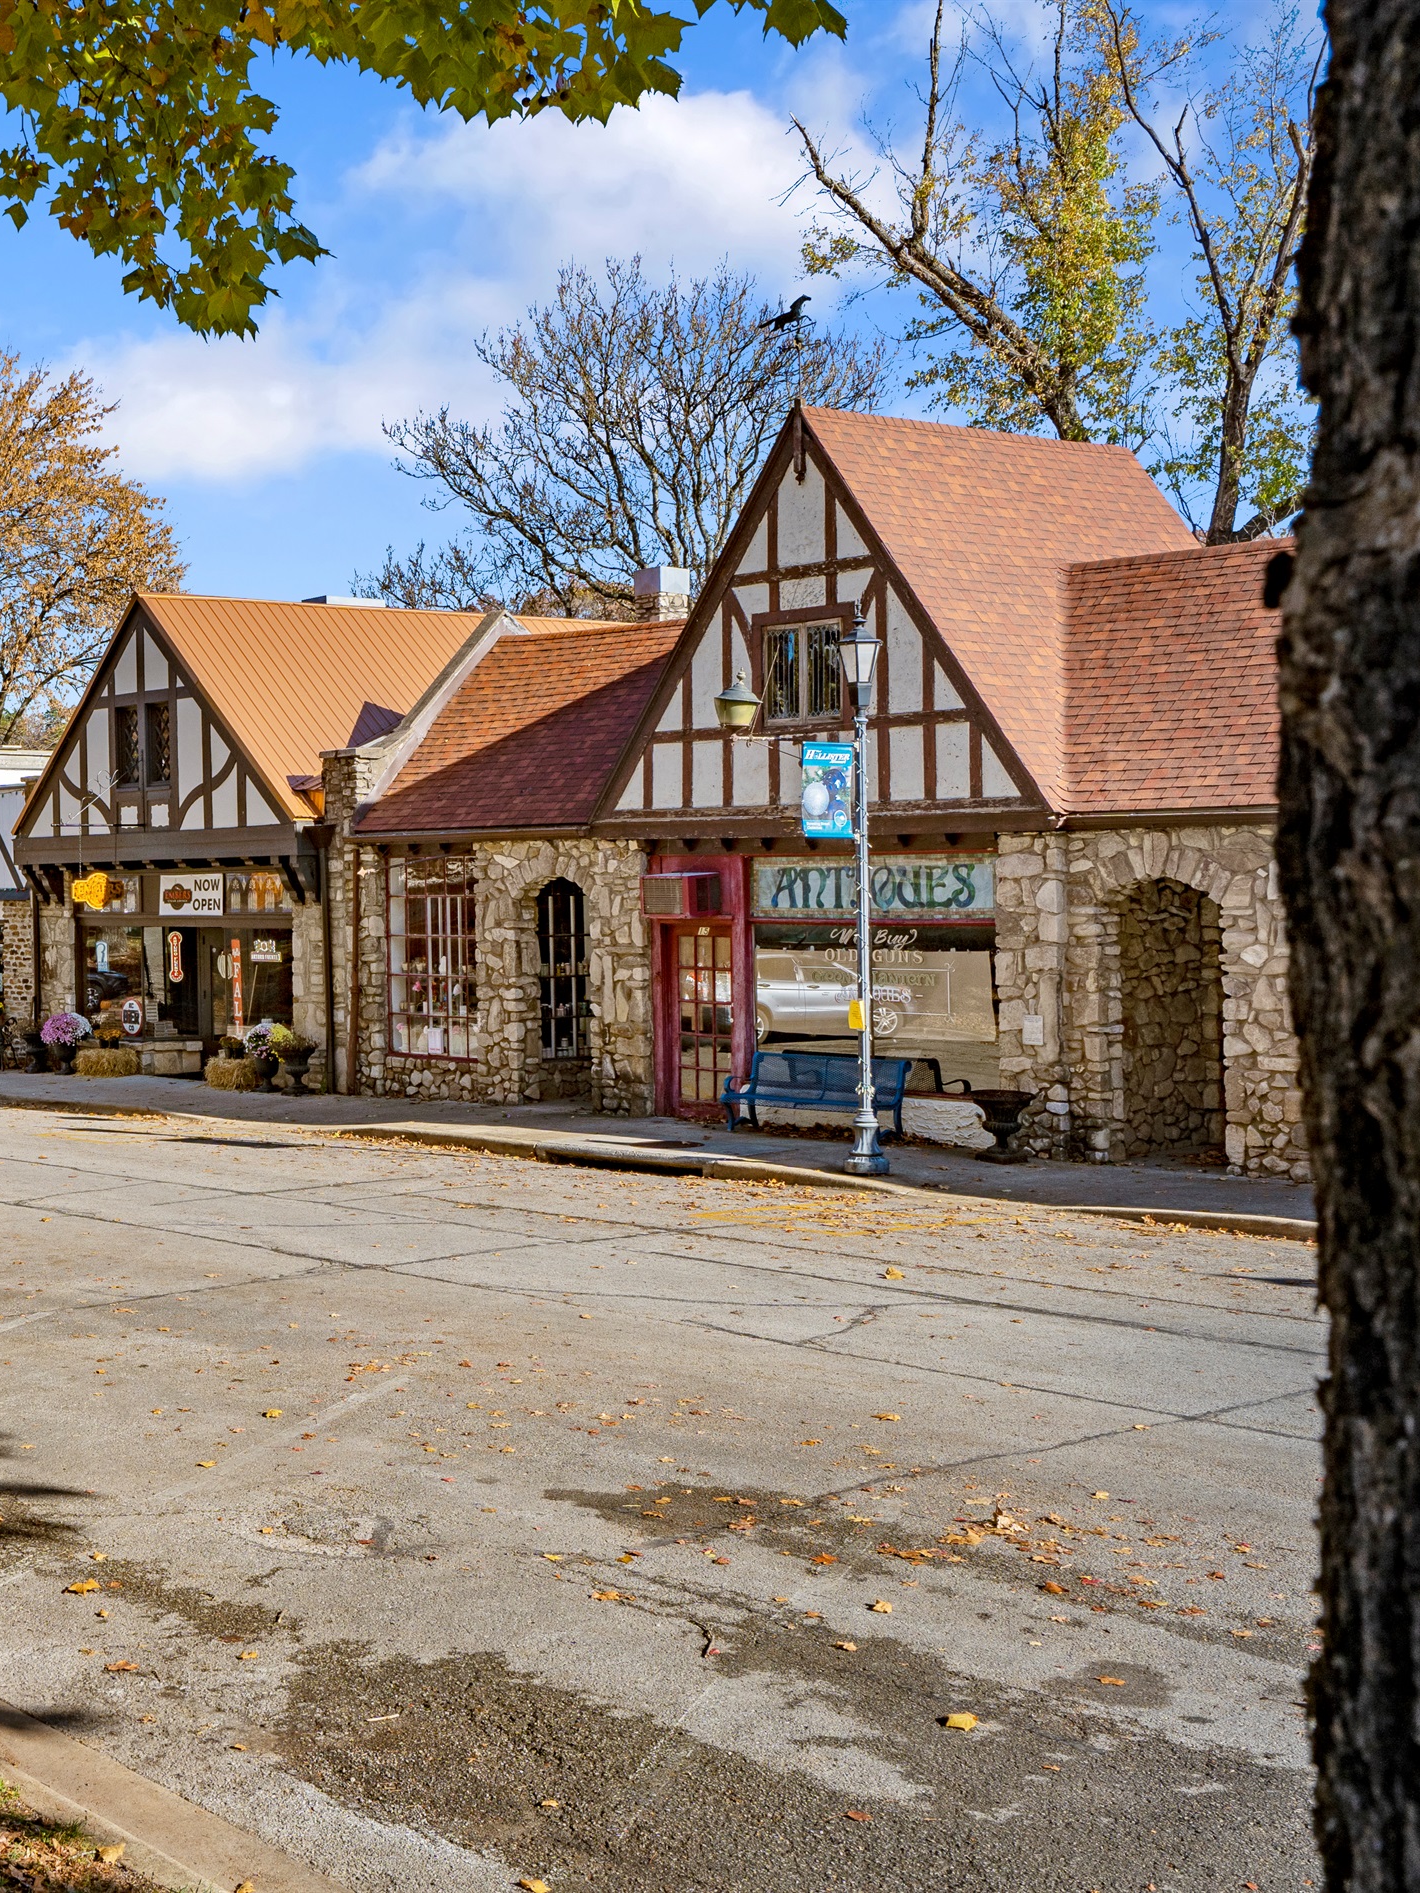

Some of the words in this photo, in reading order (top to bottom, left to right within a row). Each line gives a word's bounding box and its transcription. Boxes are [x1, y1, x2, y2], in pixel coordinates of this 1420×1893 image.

[194, 879, 220, 891] NOW
[771, 861, 976, 911] ANTQUES
[164, 890, 190, 900] EMBERS
[192, 898, 220, 911] OPEN
[699, 927, 709, 935] 15
[873, 929, 918, 950] Buy
[824, 948, 858, 962] OLD
[872, 949, 924, 964] GUNS
[233, 962, 243, 1036] FALL
[835, 987, 911, 1004] ANQUES
